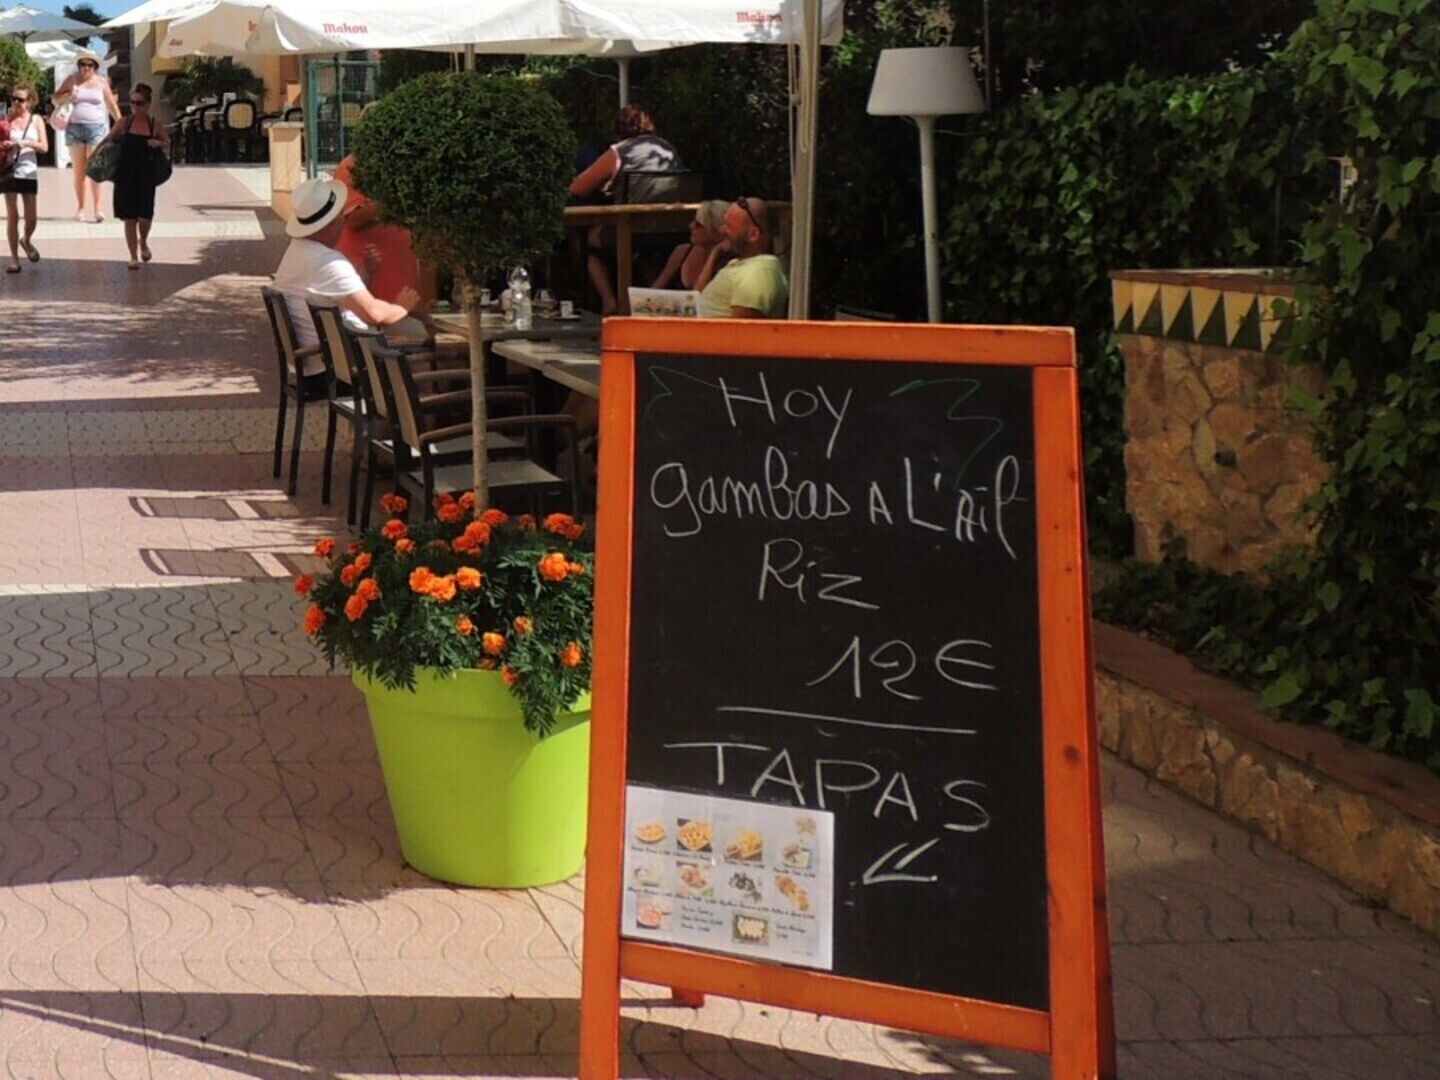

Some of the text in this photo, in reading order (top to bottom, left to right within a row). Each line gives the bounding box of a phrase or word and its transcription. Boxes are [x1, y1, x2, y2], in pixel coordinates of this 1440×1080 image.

[323, 22, 369, 34] Mahou
[869, 481, 893, 525] A
[759, 538, 881, 610] Riz
[663, 742, 991, 832] TAPAS
